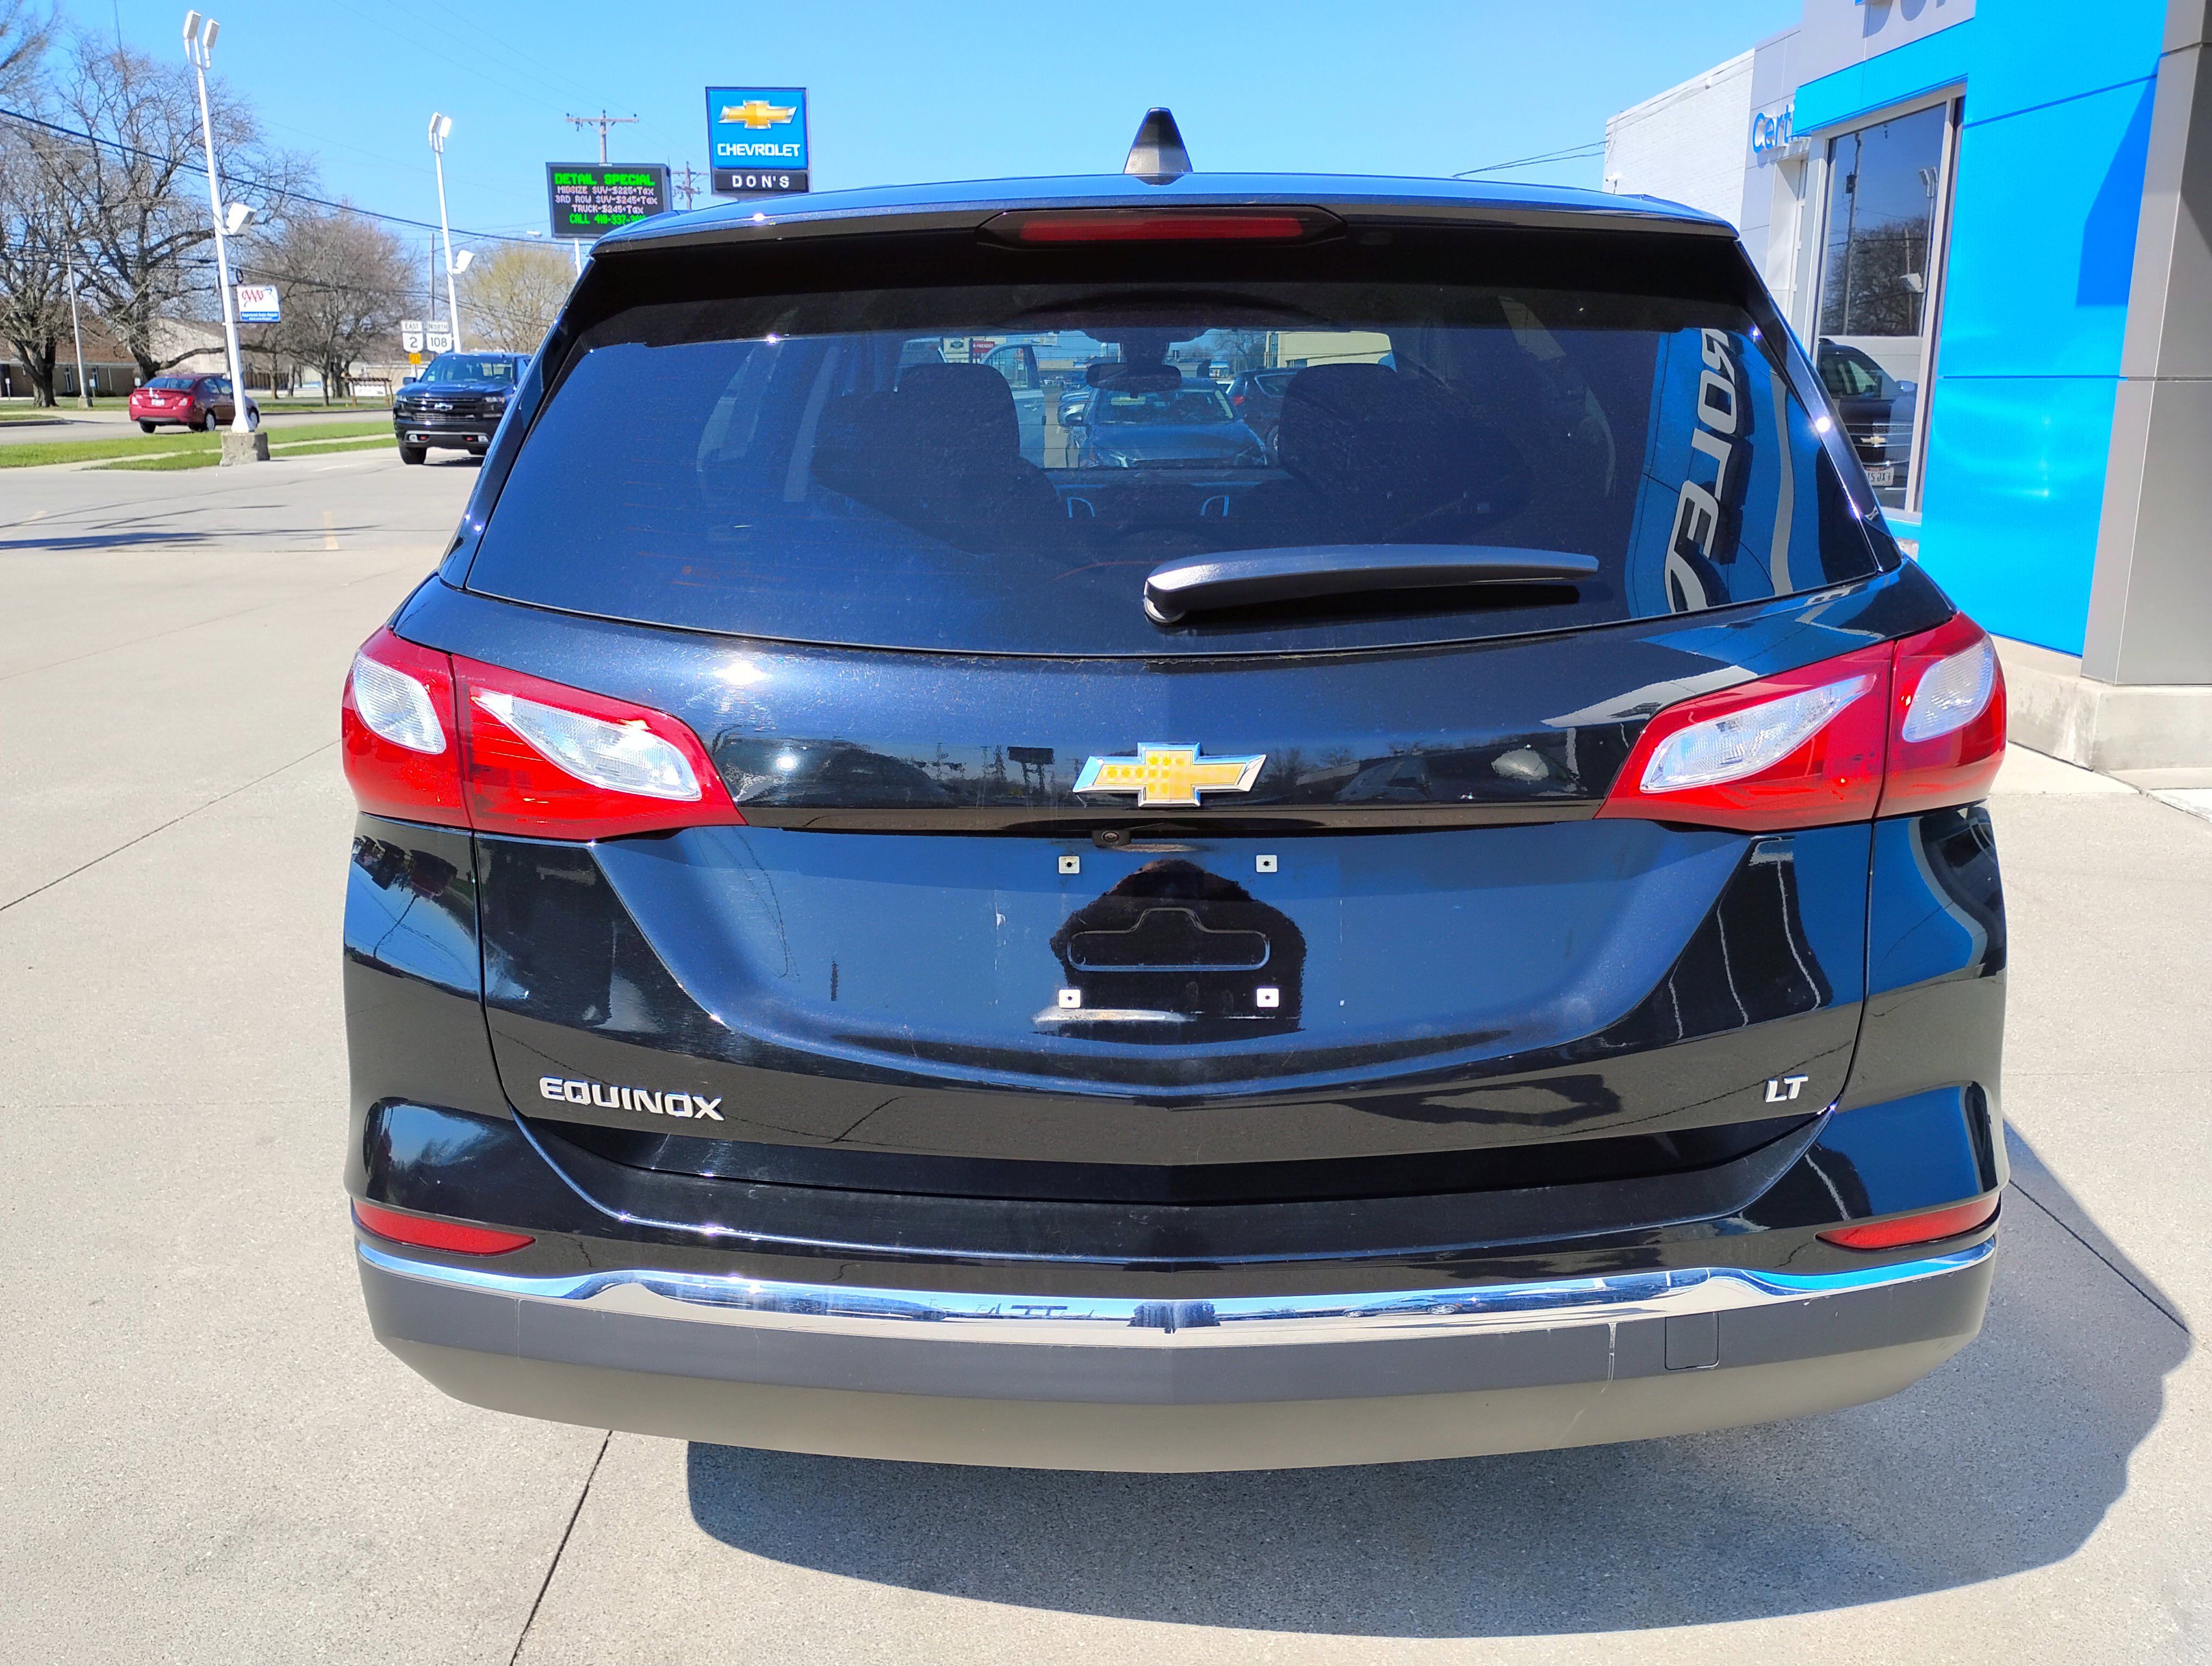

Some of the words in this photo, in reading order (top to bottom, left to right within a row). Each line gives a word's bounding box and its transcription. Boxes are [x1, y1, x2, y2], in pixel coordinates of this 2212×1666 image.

[717, 143, 801, 157] CHEVROLET
[554, 172, 597, 185] DETAIL
[603, 173, 655, 186] SPECIAL
[732, 175, 790, 188] DON'S
[557, 185, 588, 194] MIDSIZE
[555, 194, 571, 204] 3RD
[575, 195, 592, 204] ROW
[569, 214, 590, 224] CALL
[409, 336, 417, 348] 2
[430, 337, 447, 348] 108
[1765, 1074, 1809, 1103] LT
[539, 1075, 725, 1121] EQUINOX
